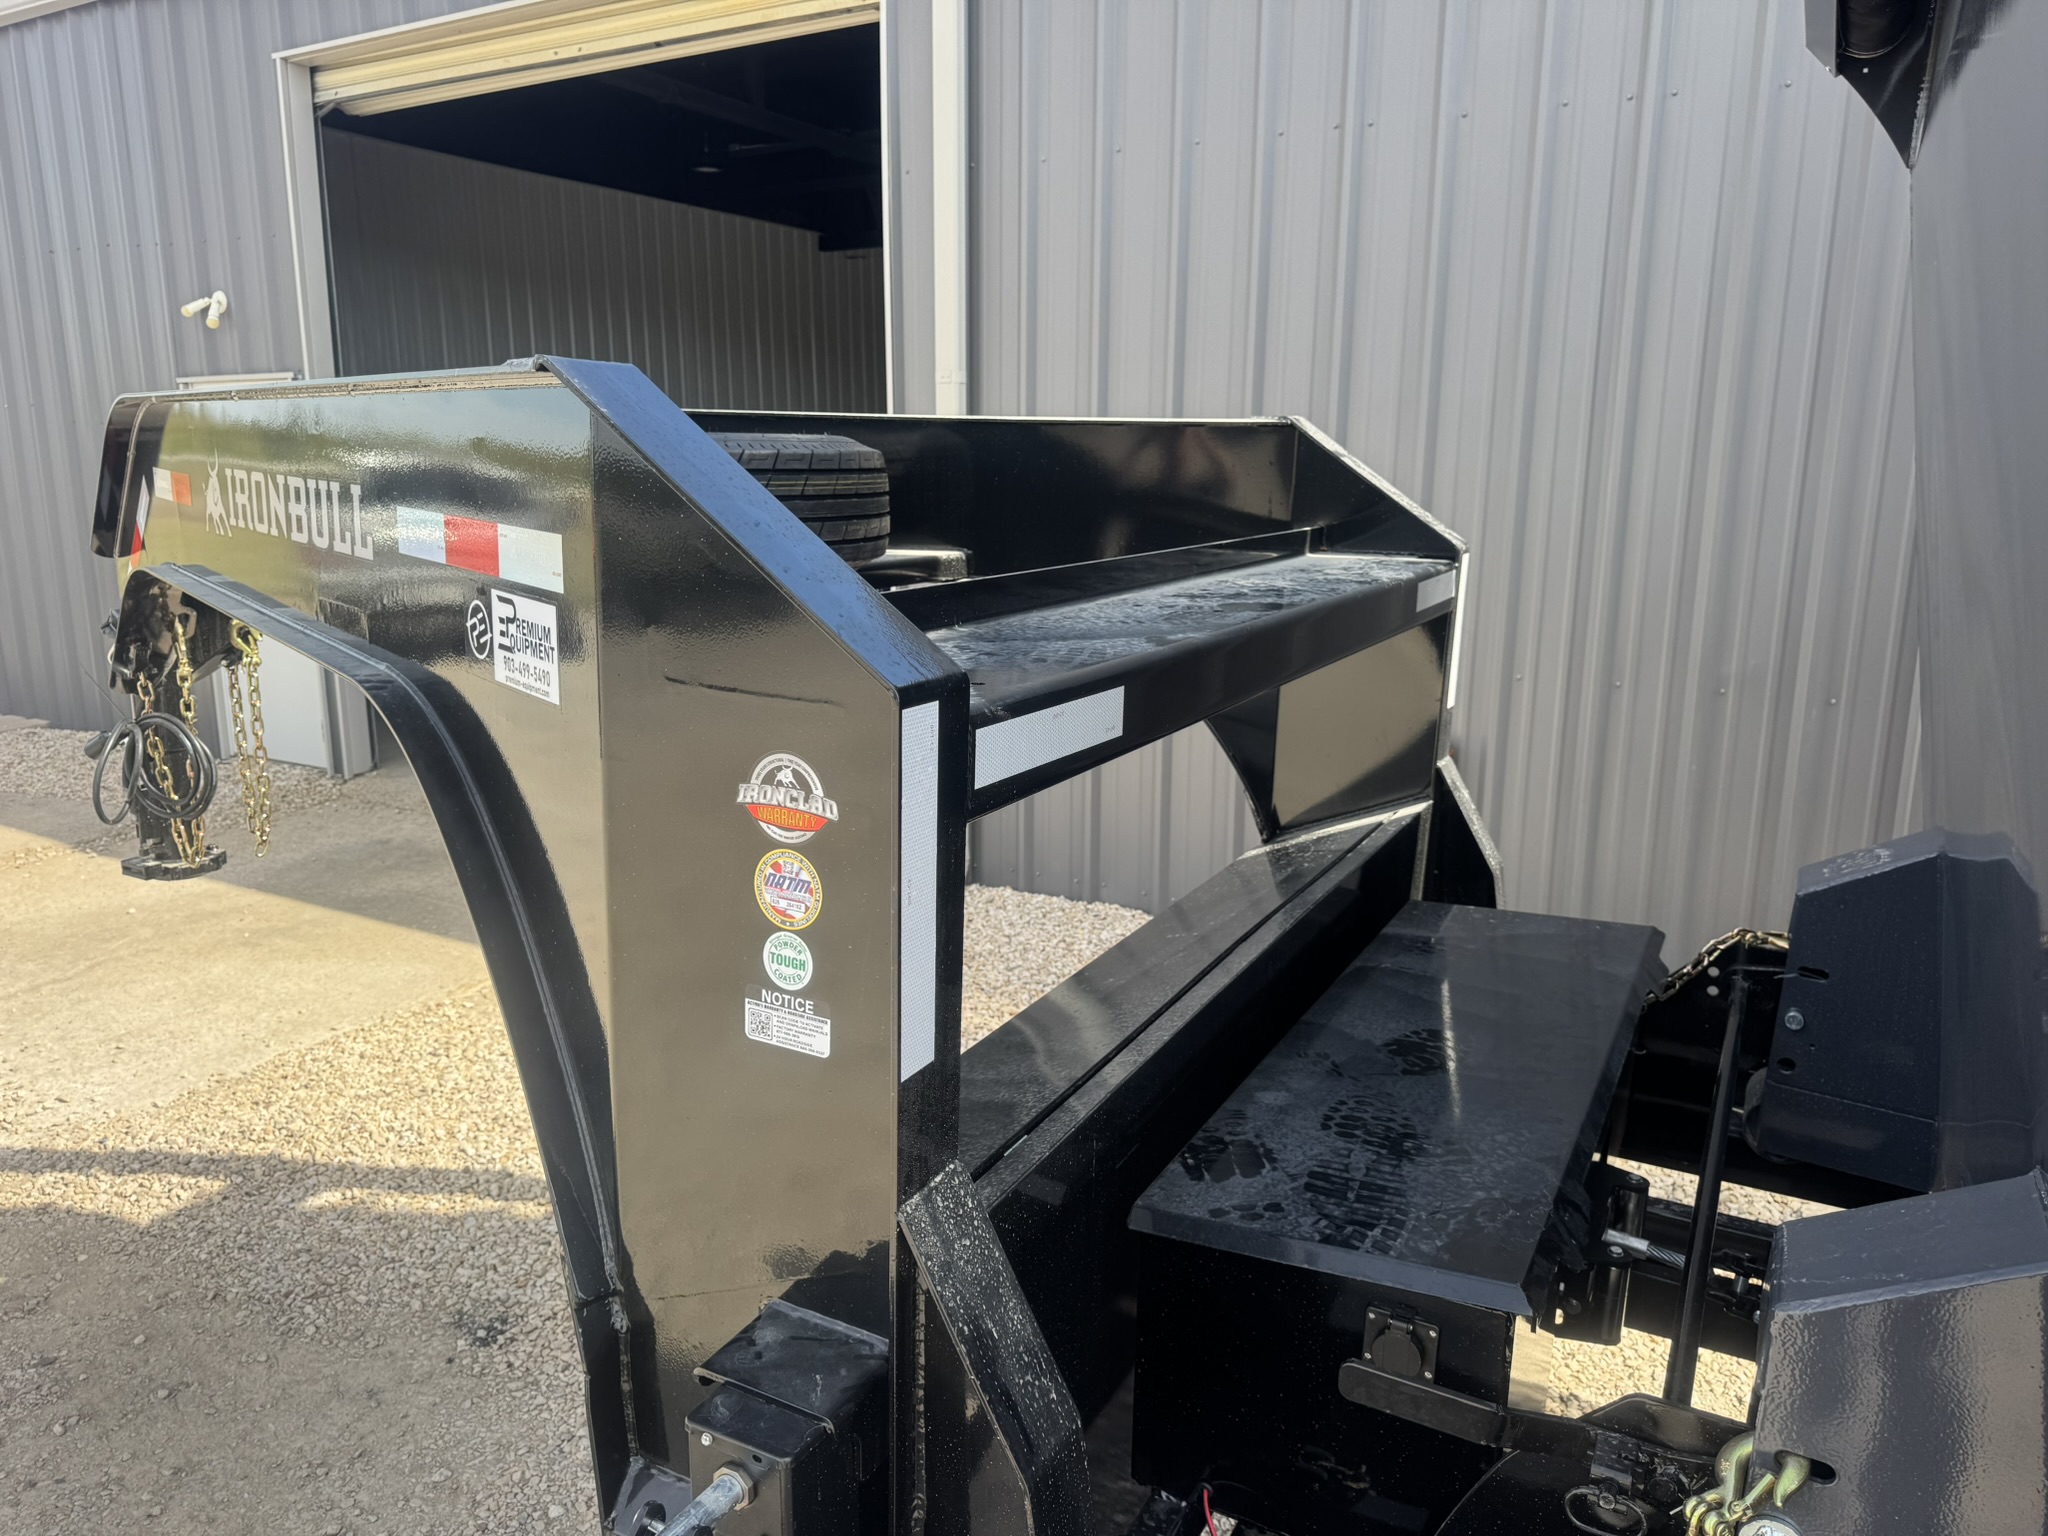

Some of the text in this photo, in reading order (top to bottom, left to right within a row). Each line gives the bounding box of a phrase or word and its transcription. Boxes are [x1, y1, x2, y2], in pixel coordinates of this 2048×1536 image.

[225, 468, 373, 561] IRONBULL
[496, 594, 551, 645] PREMIUM
[503, 655, 551, 687] 903-499-5490
[736, 783, 839, 821] IRONCLAD
[756, 806, 817, 829] WARRANTY
[774, 940, 802, 956] POWDER
[770, 952, 806, 972] TOUGH
[774, 968, 802, 982] COATED
[761, 988, 814, 1014] NOTICE
